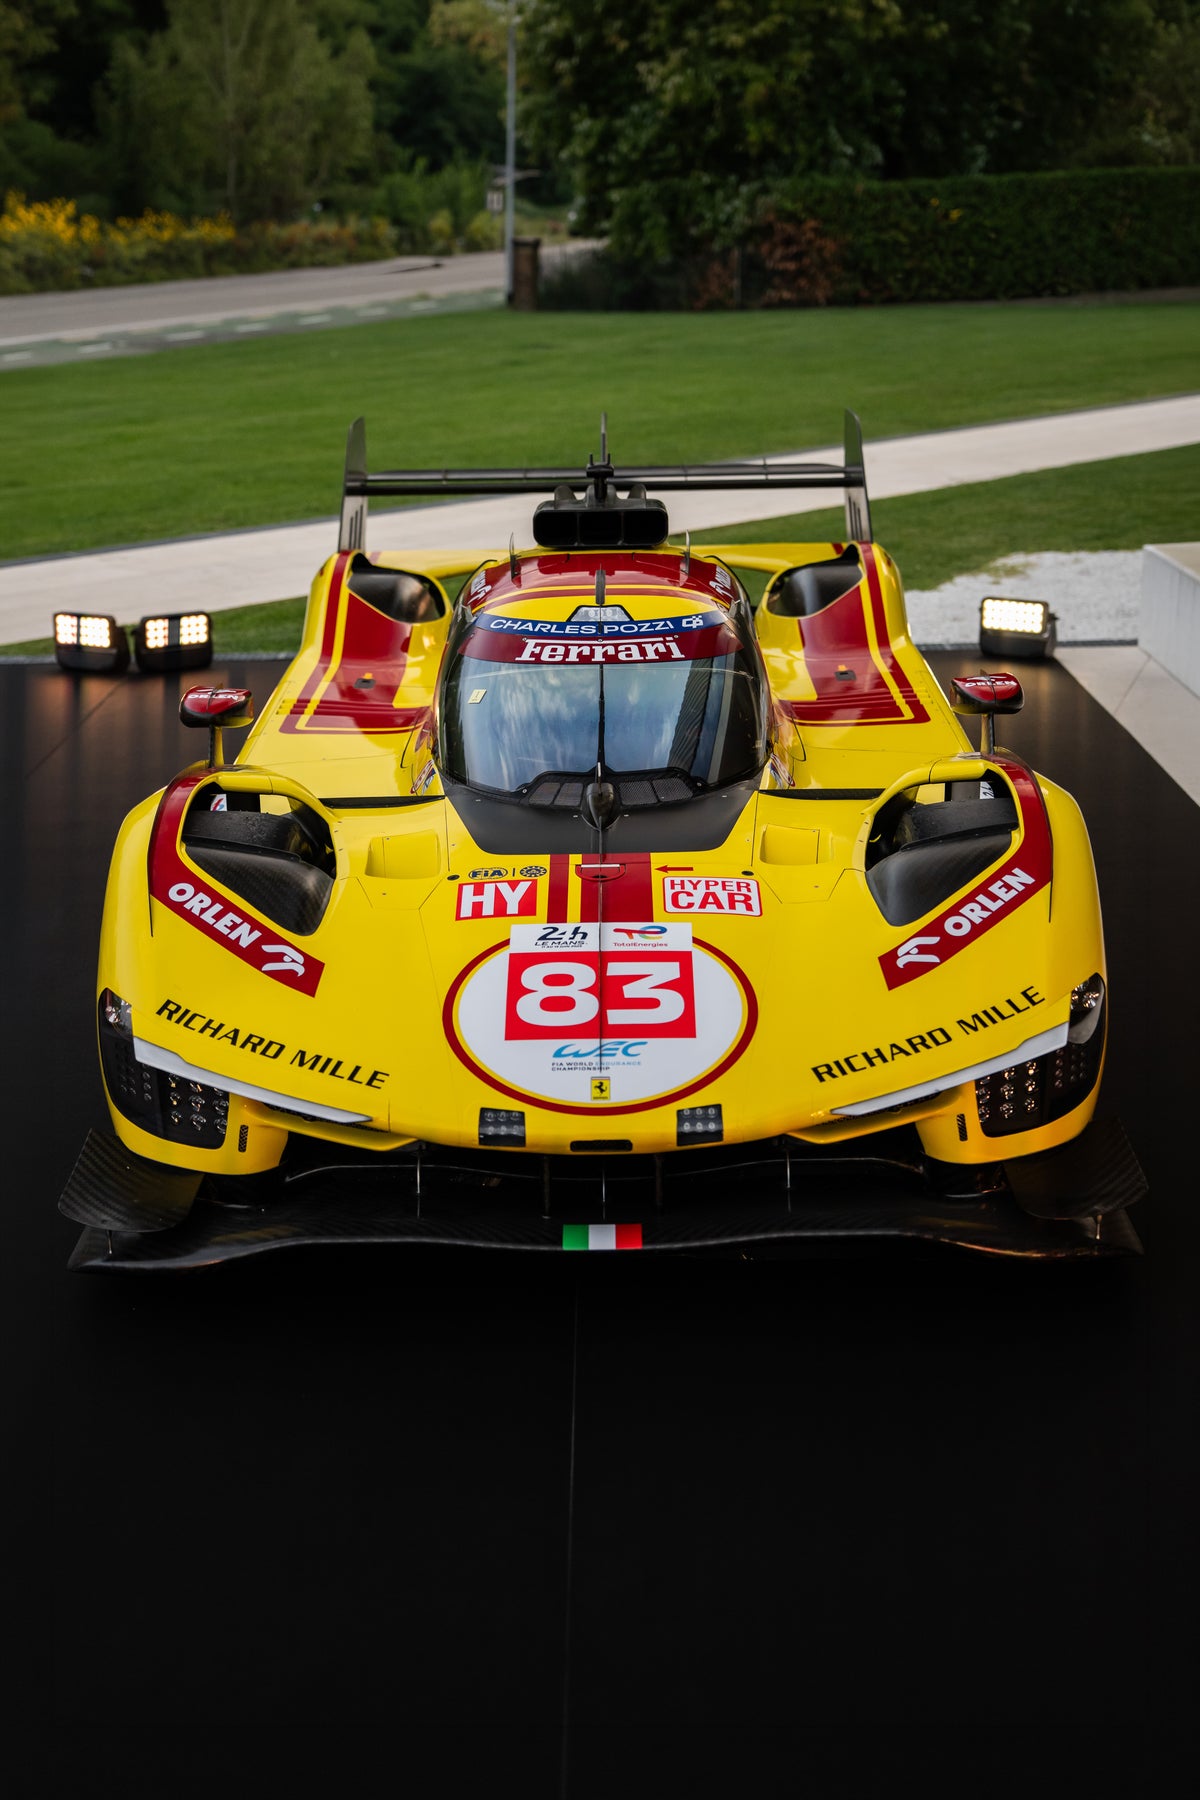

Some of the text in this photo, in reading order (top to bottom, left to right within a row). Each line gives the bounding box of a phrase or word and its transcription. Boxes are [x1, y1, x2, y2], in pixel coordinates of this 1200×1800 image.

[490, 619, 596, 634] CHARLES
[604, 620, 674, 634] POZZI
[515, 636, 685, 662] Ferrari
[460, 881, 533, 918] HY
[670, 879, 752, 893] HYPER
[671, 891, 754, 912] CAR
[944, 867, 1036, 937] ORLEN
[168, 882, 262, 949] ORLEN
[516, 961, 685, 1027] 83
[156, 998, 390, 1090] RICHARD MILLE
[552, 1041, 649, 1058] WEC
[811, 985, 1046, 1083] RICHARD MILLE
